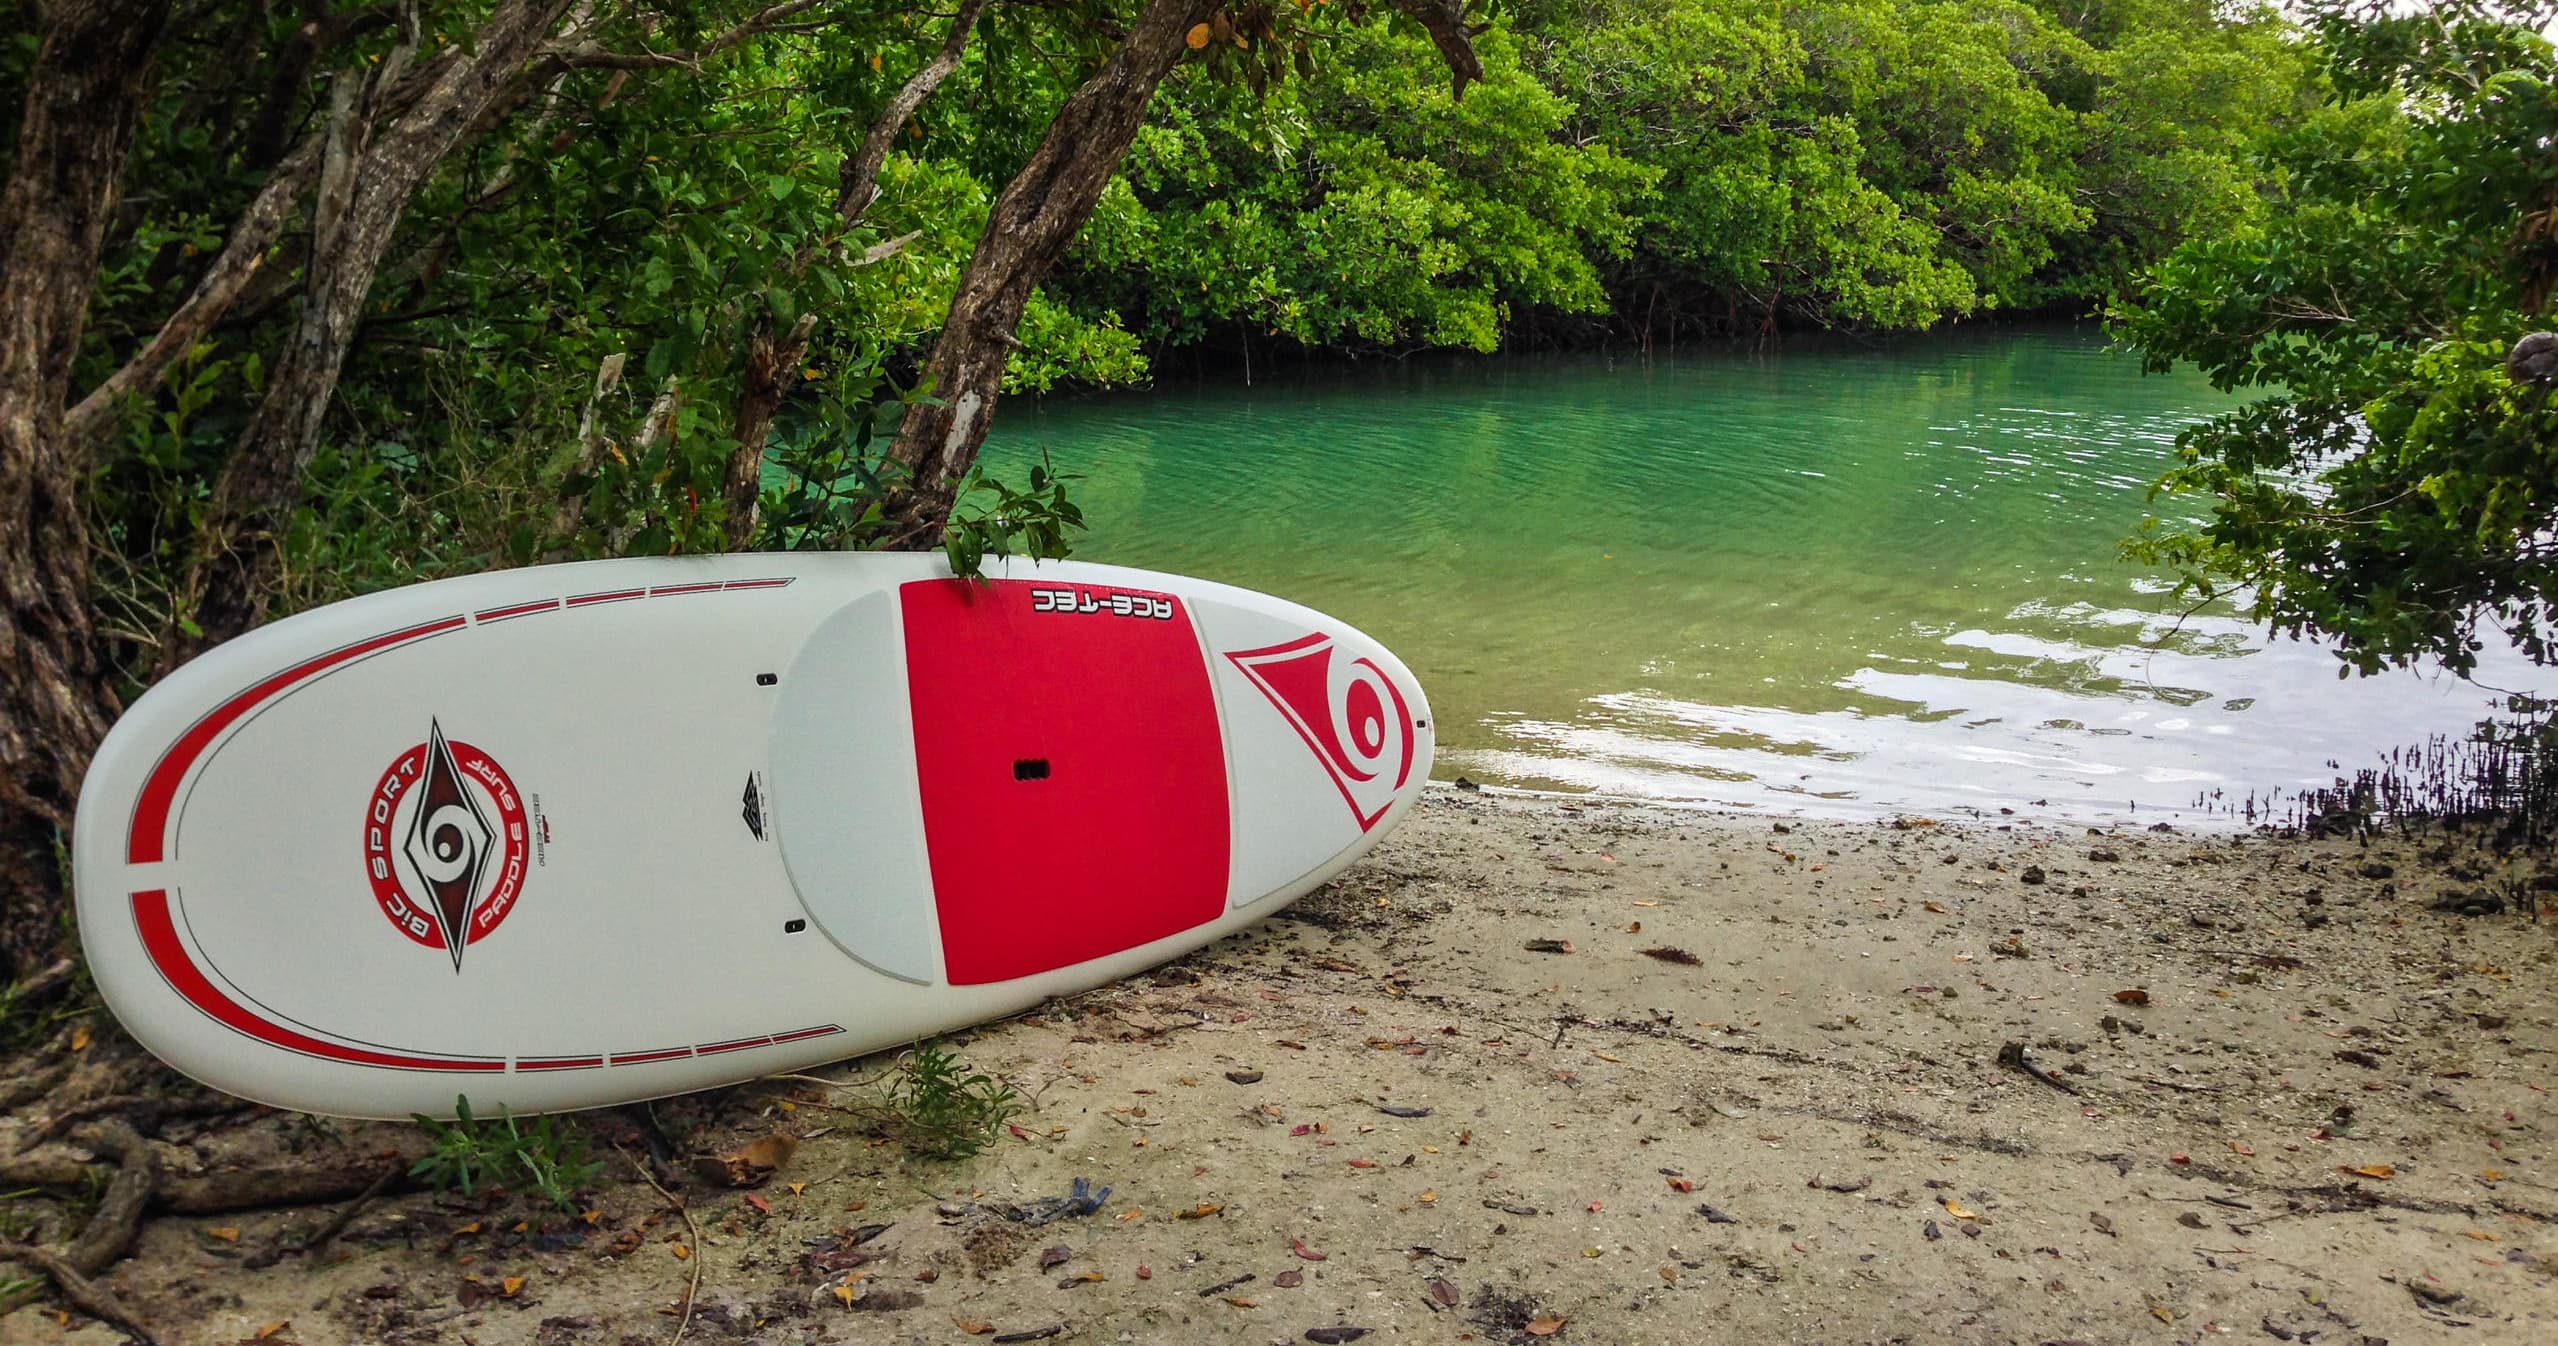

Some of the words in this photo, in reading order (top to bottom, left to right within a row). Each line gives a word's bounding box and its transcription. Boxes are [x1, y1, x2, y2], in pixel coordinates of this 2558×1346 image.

[1032, 589, 1174, 620] ACE-TEC
[370, 757, 415, 881] SPORT
[466, 758, 517, 812] SURF
[478, 822, 523, 928] PADDLE
